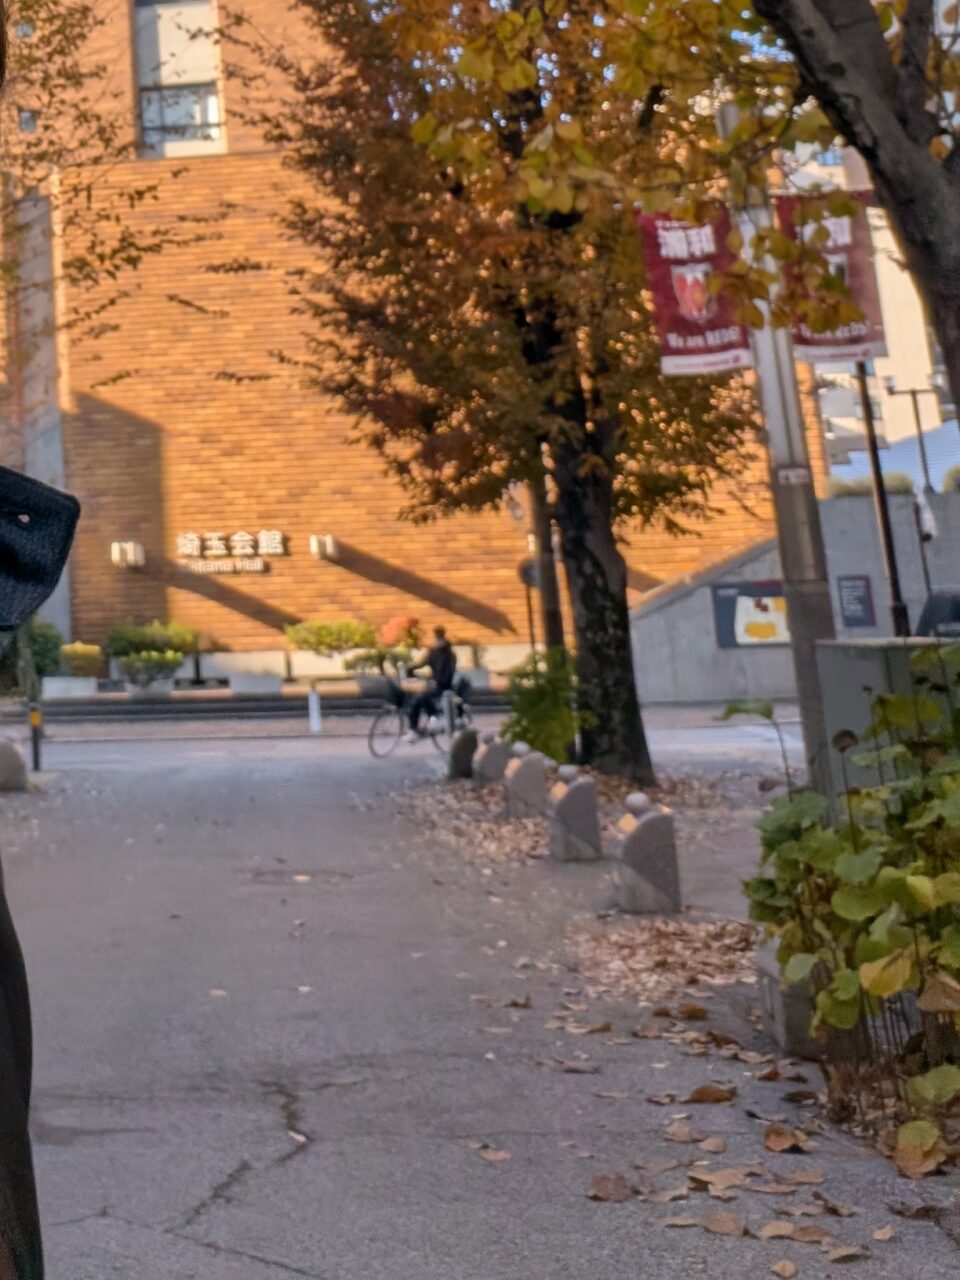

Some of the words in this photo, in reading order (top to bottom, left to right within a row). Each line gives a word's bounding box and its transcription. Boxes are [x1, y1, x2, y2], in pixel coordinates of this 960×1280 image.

[176, 529, 285, 557] 埼玉会館
[235, 557, 264, 572] Hall
